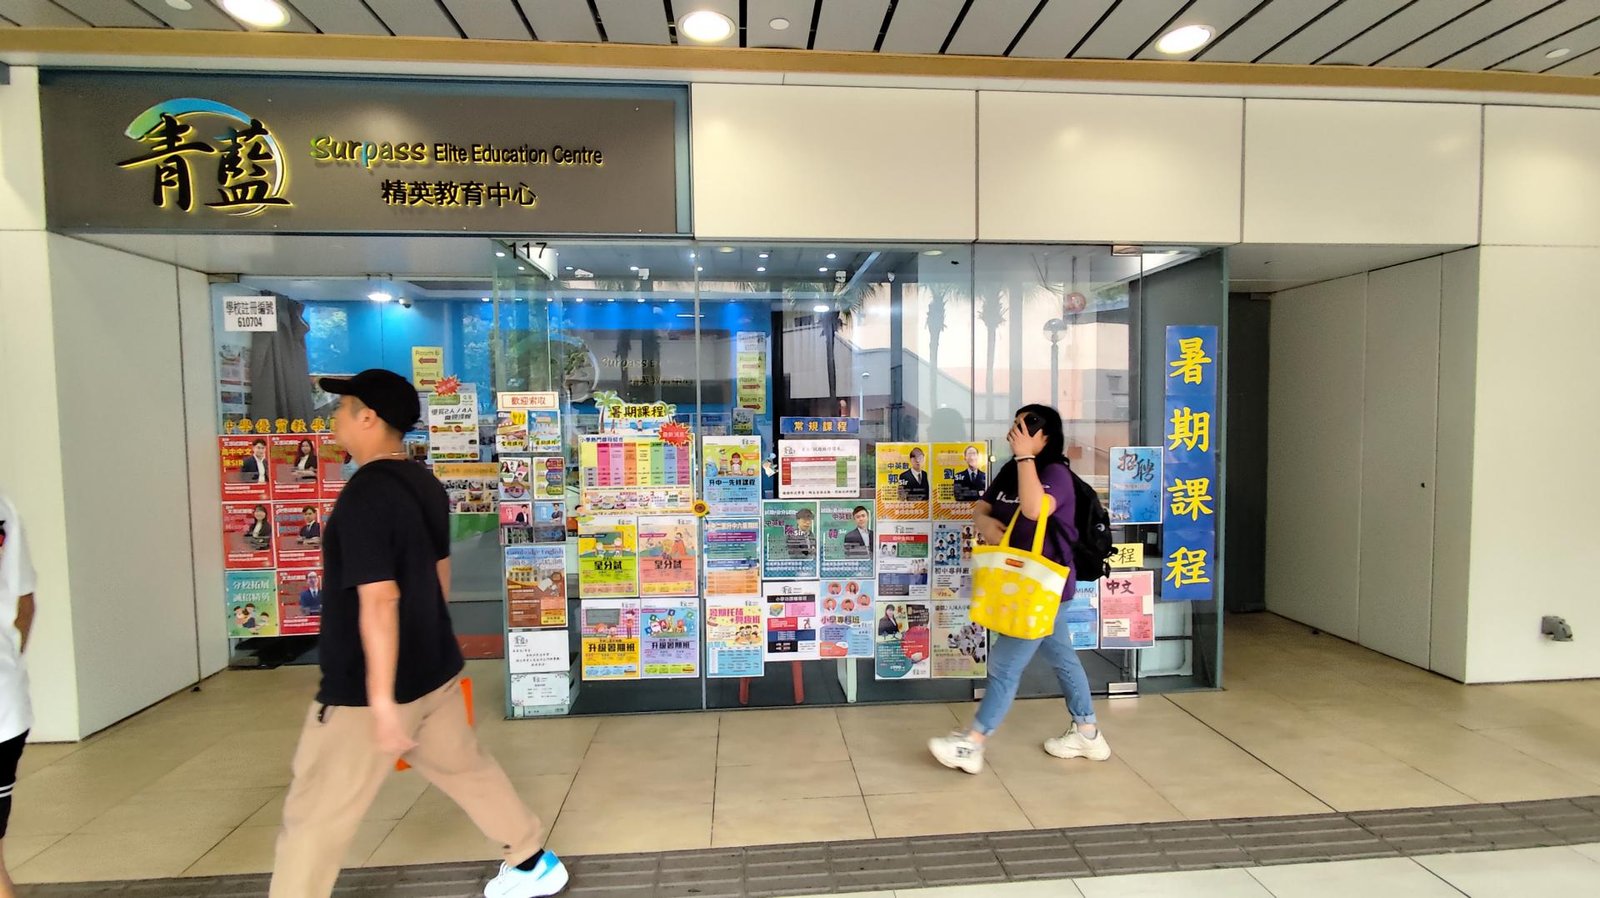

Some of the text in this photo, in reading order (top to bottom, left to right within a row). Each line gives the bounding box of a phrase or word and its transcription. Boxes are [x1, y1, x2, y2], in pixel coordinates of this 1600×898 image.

[310, 136, 604, 168] Surpass Elite Education Centre
[116, 113, 293, 212] 青藍
[381, 179, 537, 208] 精英教育中心
[508, 242, 548, 260] 117
[237, 316, 263, 328] 610704
[611, 405, 665, 418] 暑期課程
[793, 421, 847, 432] 常規課程
[1117, 449, 1155, 482] 招聘
[1165, 337, 1214, 588] 暑期課程
[594, 560, 622, 570] 呈分試
[654, 560, 682, 570] 呈分試
[1106, 580, 1134, 595] 中文
[588, 643, 635, 652] 升級暑期班
[651, 641, 690, 650] 升級暑期班
